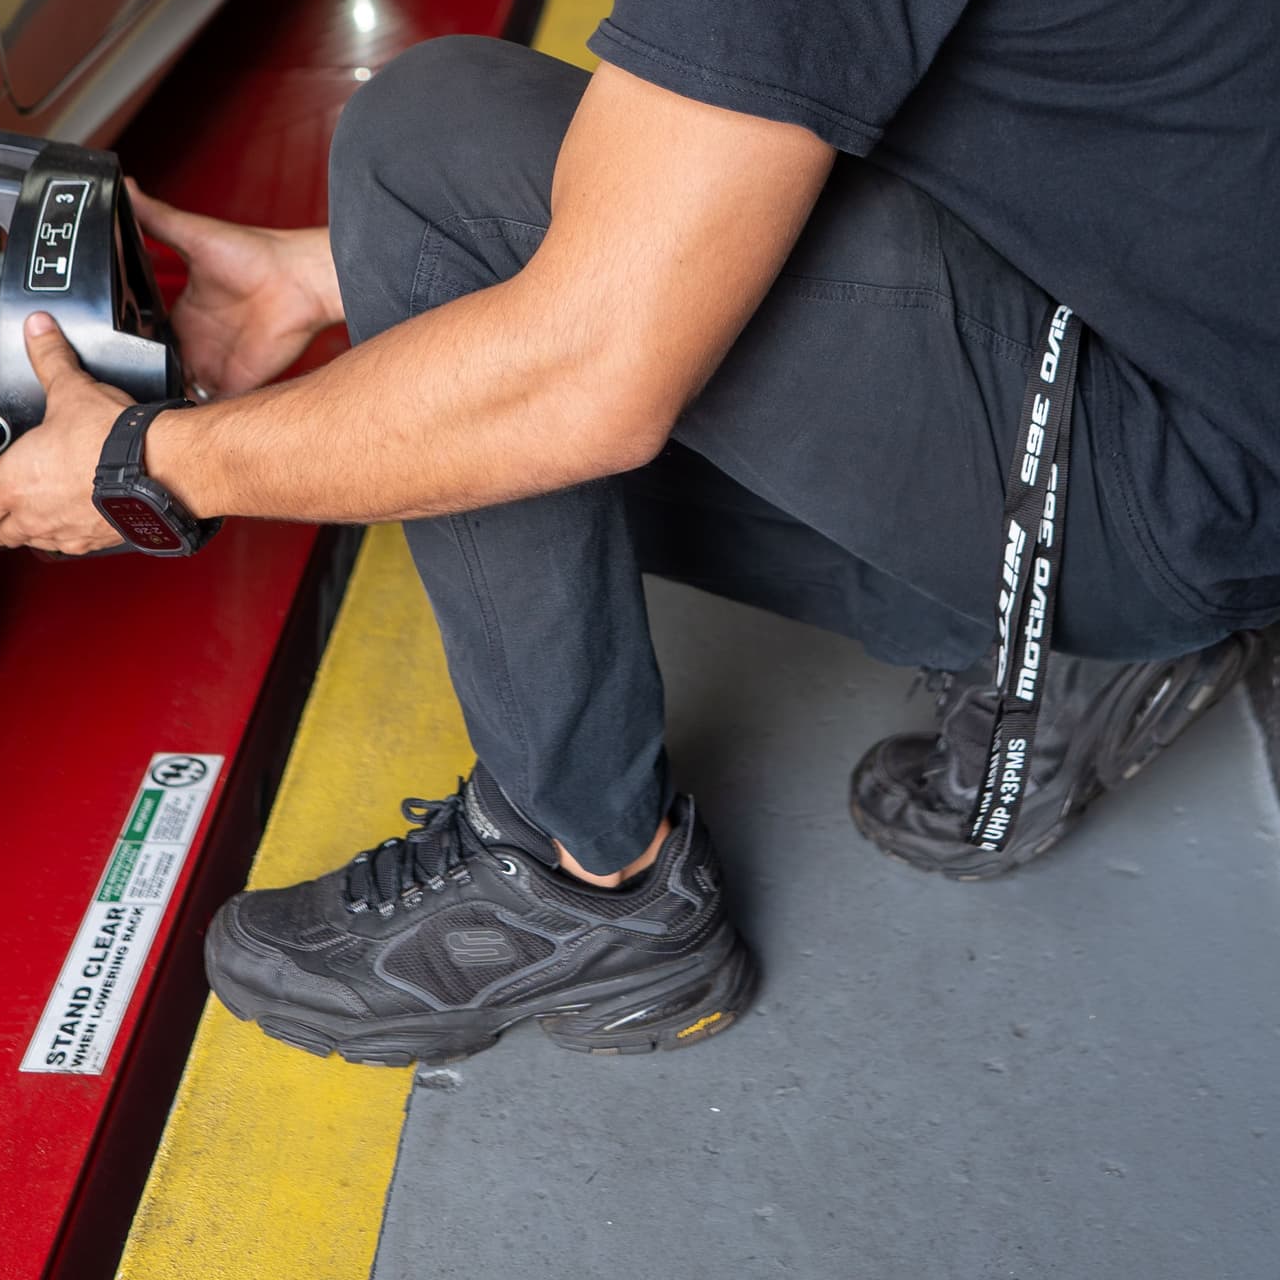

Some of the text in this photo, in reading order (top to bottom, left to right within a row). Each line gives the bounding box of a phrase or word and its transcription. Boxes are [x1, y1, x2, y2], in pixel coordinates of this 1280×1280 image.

[1021, 393, 1050, 486] 365
[982, 806, 1011, 840] UHP
[1000, 738, 1026, 804] +3PMS
[46, 987, 93, 1065] STAND
[82, 907, 126, 978] CLEAR
[71, 906, 145, 1067] WHEN LOWERING RACK
